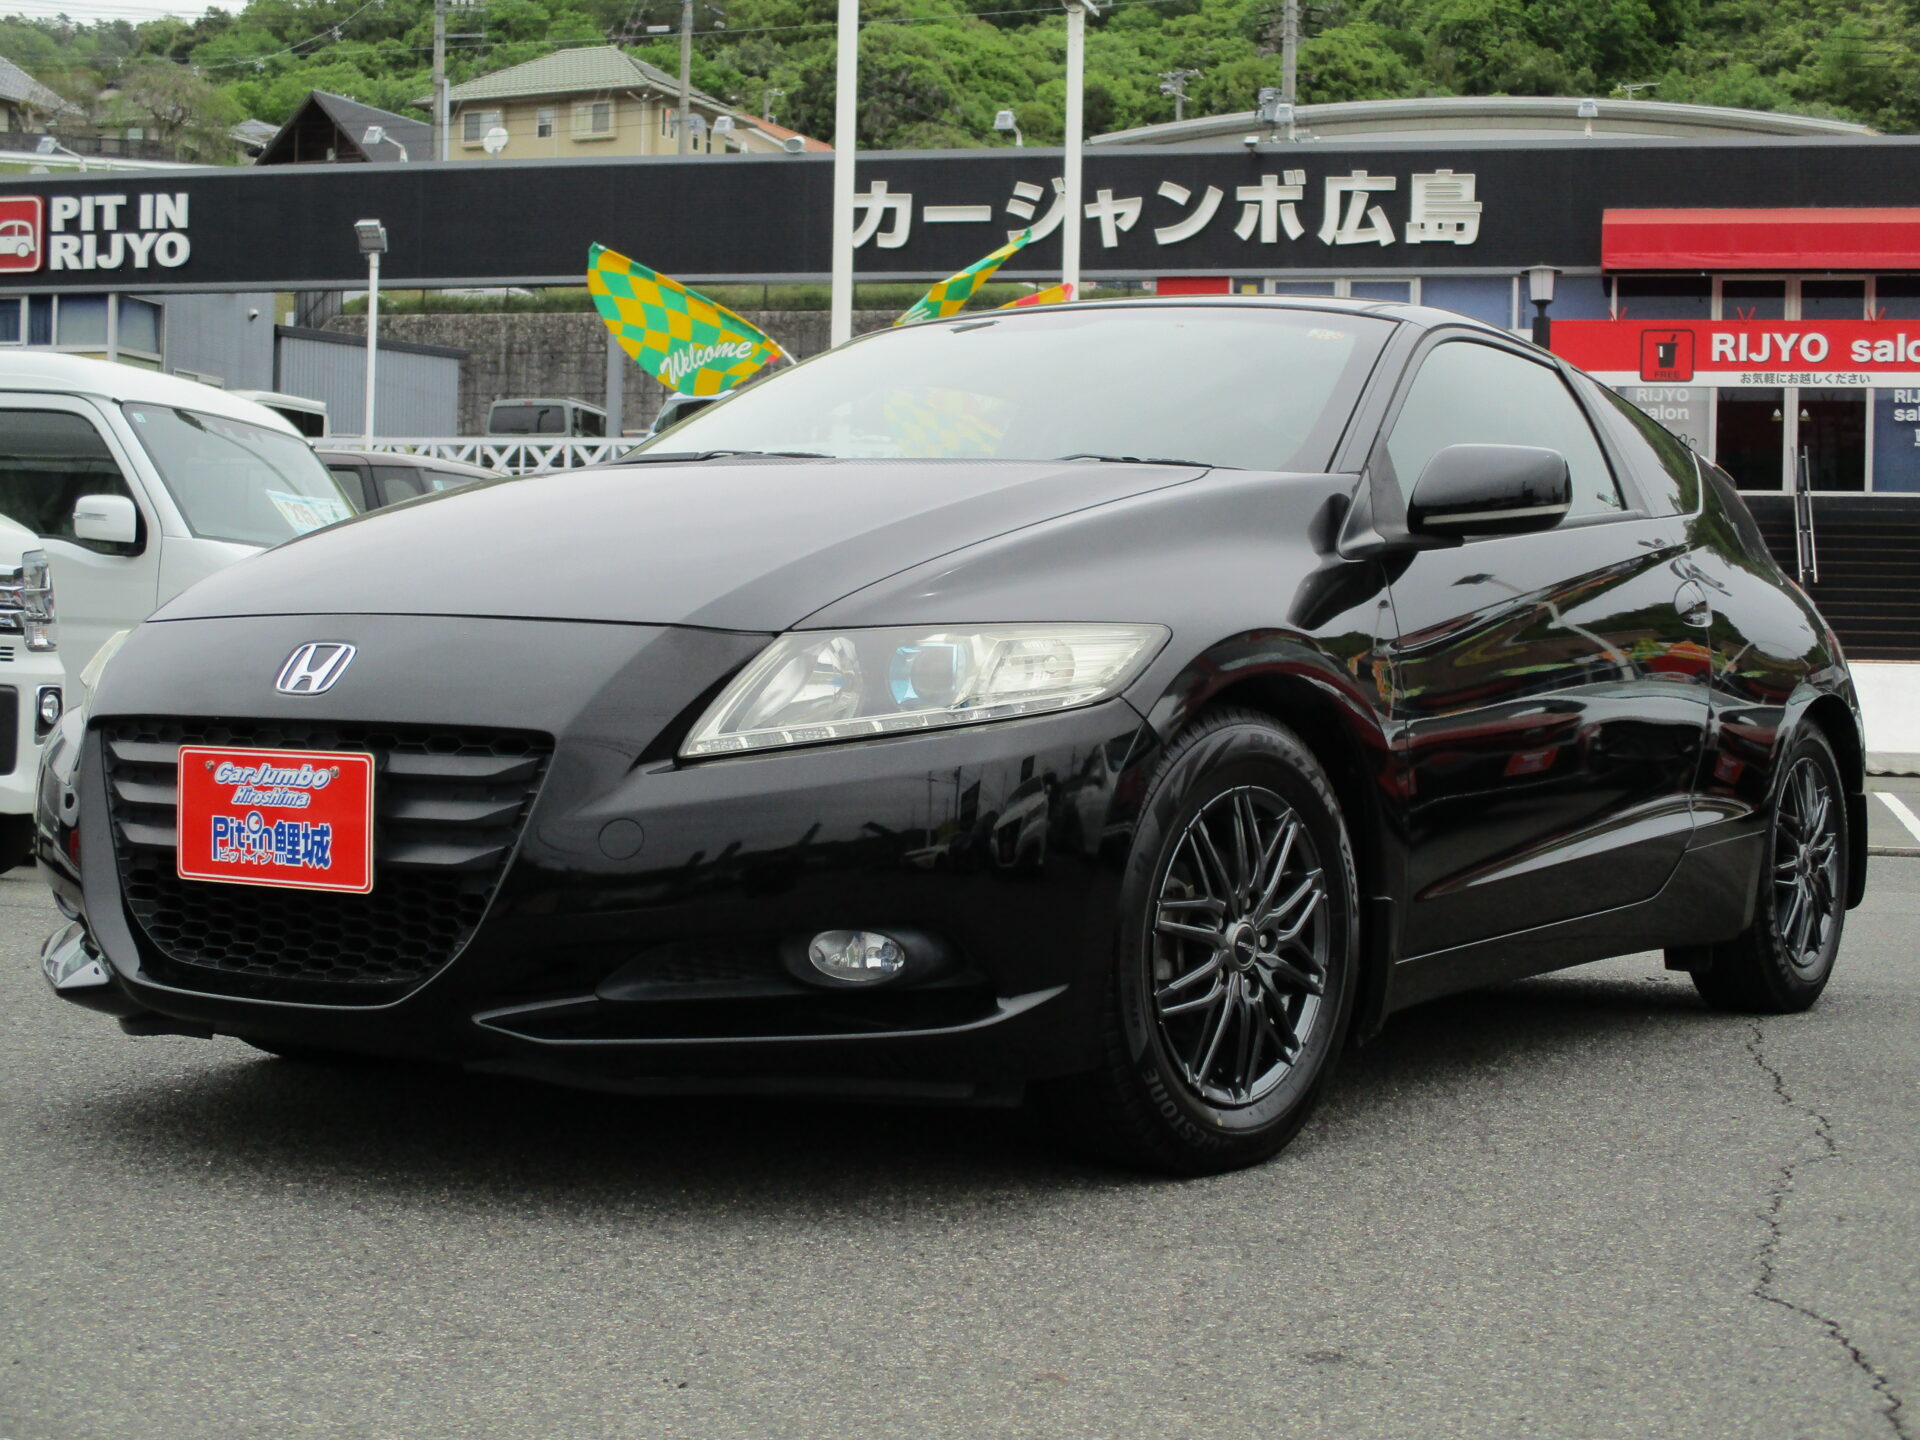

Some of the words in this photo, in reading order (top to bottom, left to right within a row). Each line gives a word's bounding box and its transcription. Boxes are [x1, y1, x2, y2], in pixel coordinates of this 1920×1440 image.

[50, 195, 126, 232] PIT
[139, 193, 189, 229] IN
[852, 169, 1482, 249] カージャンボ広島
[50, 232, 191, 270] RIJYO
[660, 341, 753, 385] Welcome
[1711, 332, 1829, 363] RIJYO
[1654, 370, 1681, 379] FREE
[1740, 373, 1871, 385] お気軽にお越しください
[1636, 388, 1690, 402] RIJYO
[231, 786, 311, 808] Hiroshima
